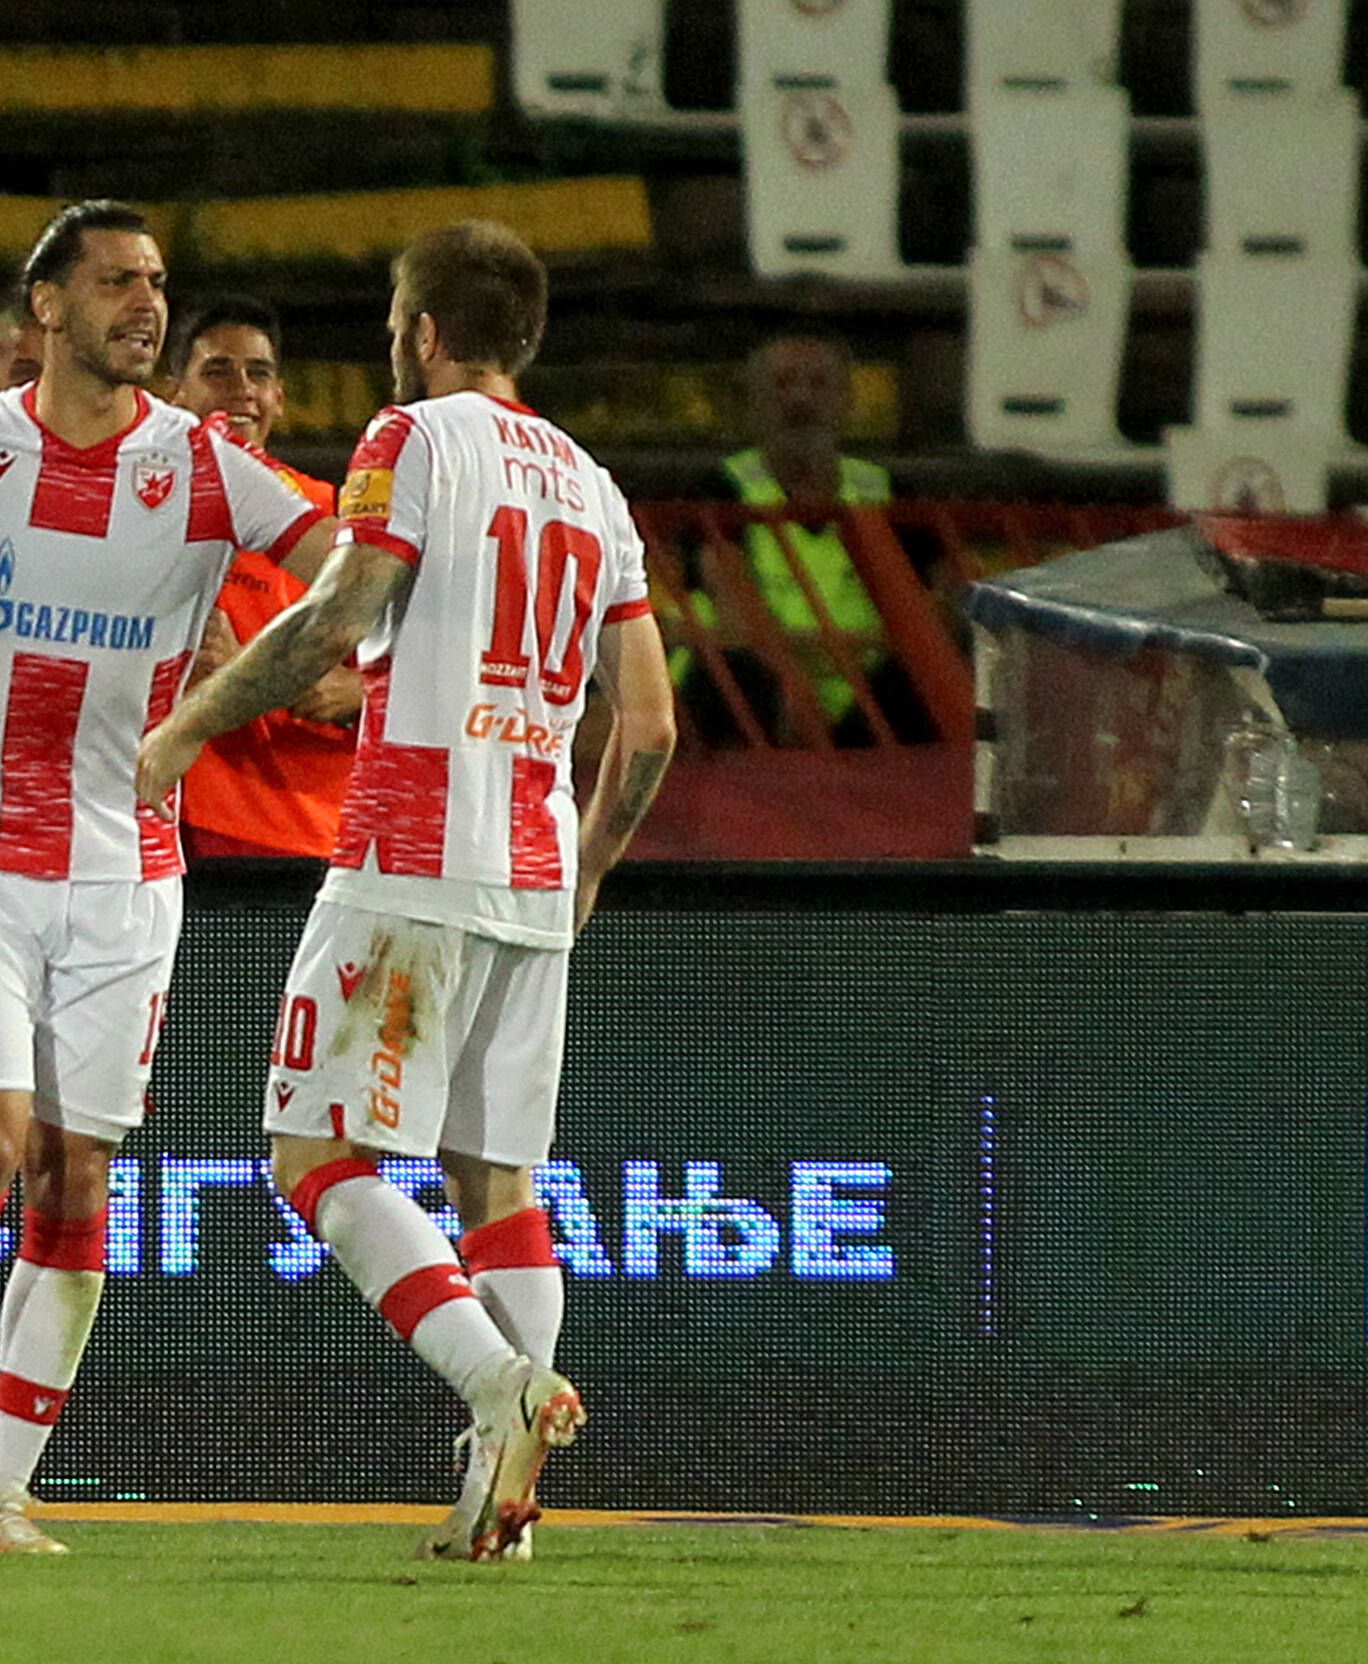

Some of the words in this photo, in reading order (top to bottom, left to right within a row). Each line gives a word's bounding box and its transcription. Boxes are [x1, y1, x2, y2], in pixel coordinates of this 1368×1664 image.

[503, 455, 586, 513] mts
[15, 601, 156, 650] GAZPROM
[479, 503, 602, 707] 10
